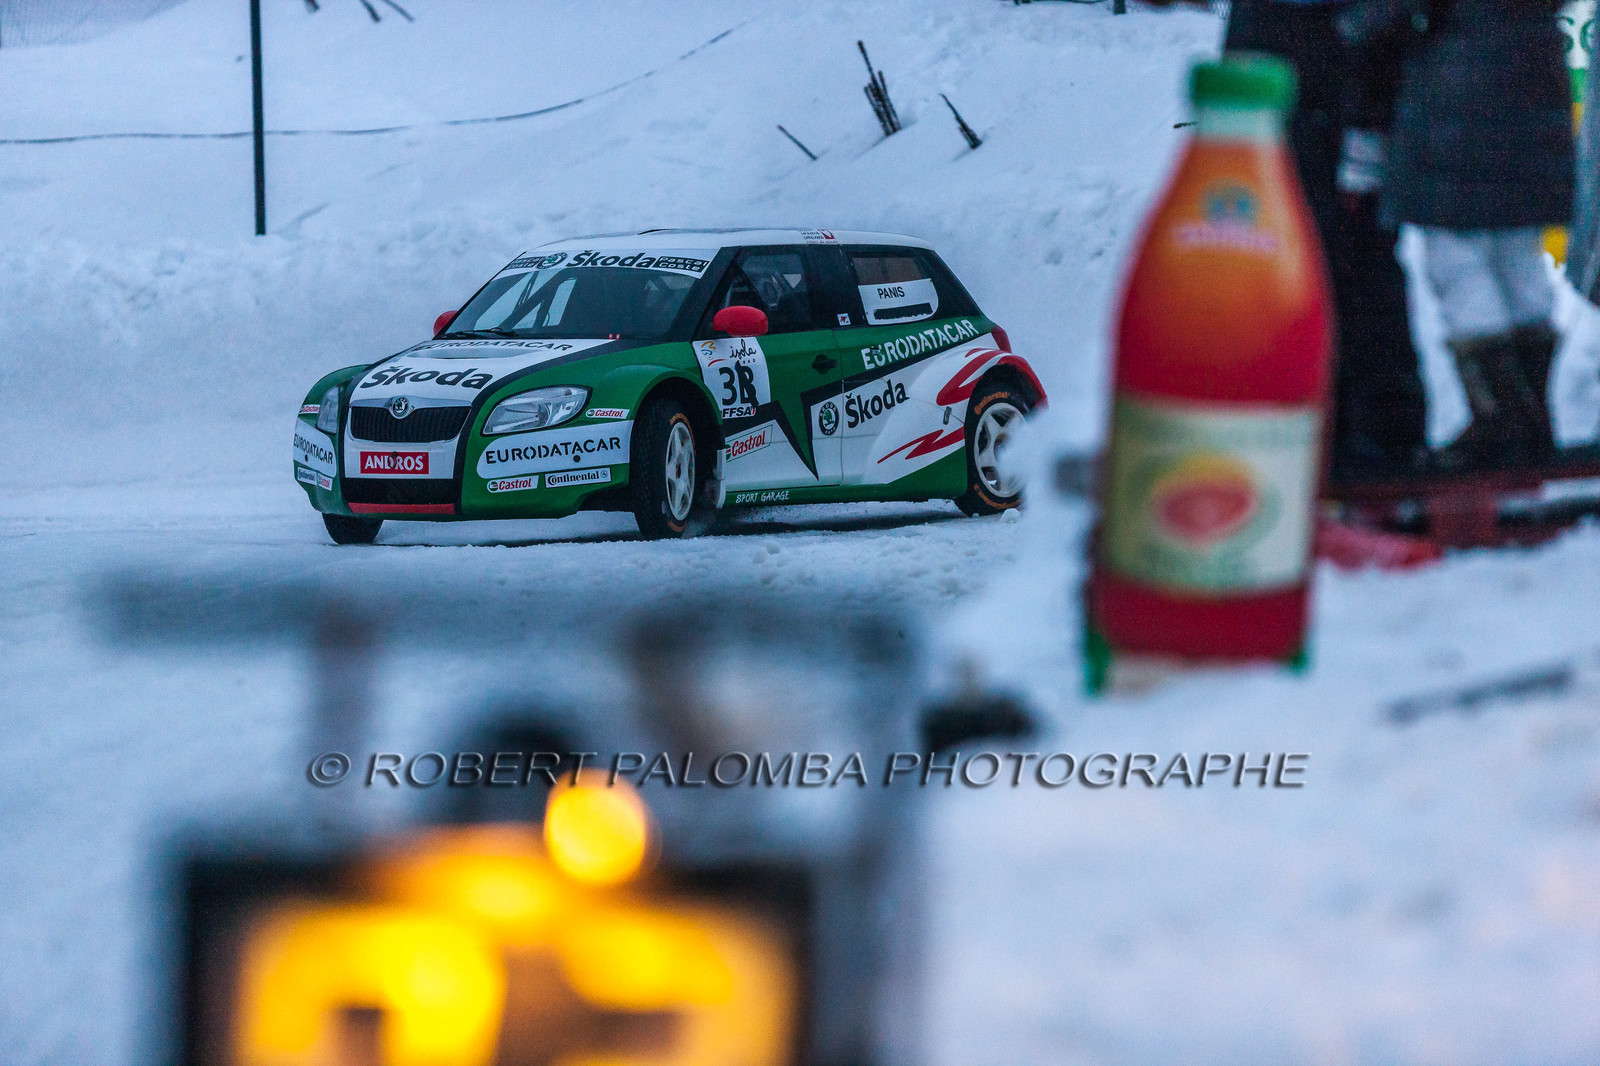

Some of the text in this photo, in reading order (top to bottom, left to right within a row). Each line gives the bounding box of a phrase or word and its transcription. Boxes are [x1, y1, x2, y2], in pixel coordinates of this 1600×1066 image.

[565, 249, 657, 268] Škoda
[877, 286, 905, 299] PANIS
[860, 319, 979, 370] EURODATACAR
[359, 365, 495, 390] Škoda
[722, 406, 752, 419] FFSA
[844, 378, 910, 429] Škoda
[594, 408, 624, 418] Castrol
[293, 433, 334, 465] EURODATACAR
[485, 436, 622, 465] EURODATACAR
[731, 430, 766, 457] Castrol
[363, 454, 424, 471] ANDROS
[498, 477, 532, 491] Castrol
[547, 470, 600, 486] Continental
[735, 490, 790, 504] SPORT GARAGE
